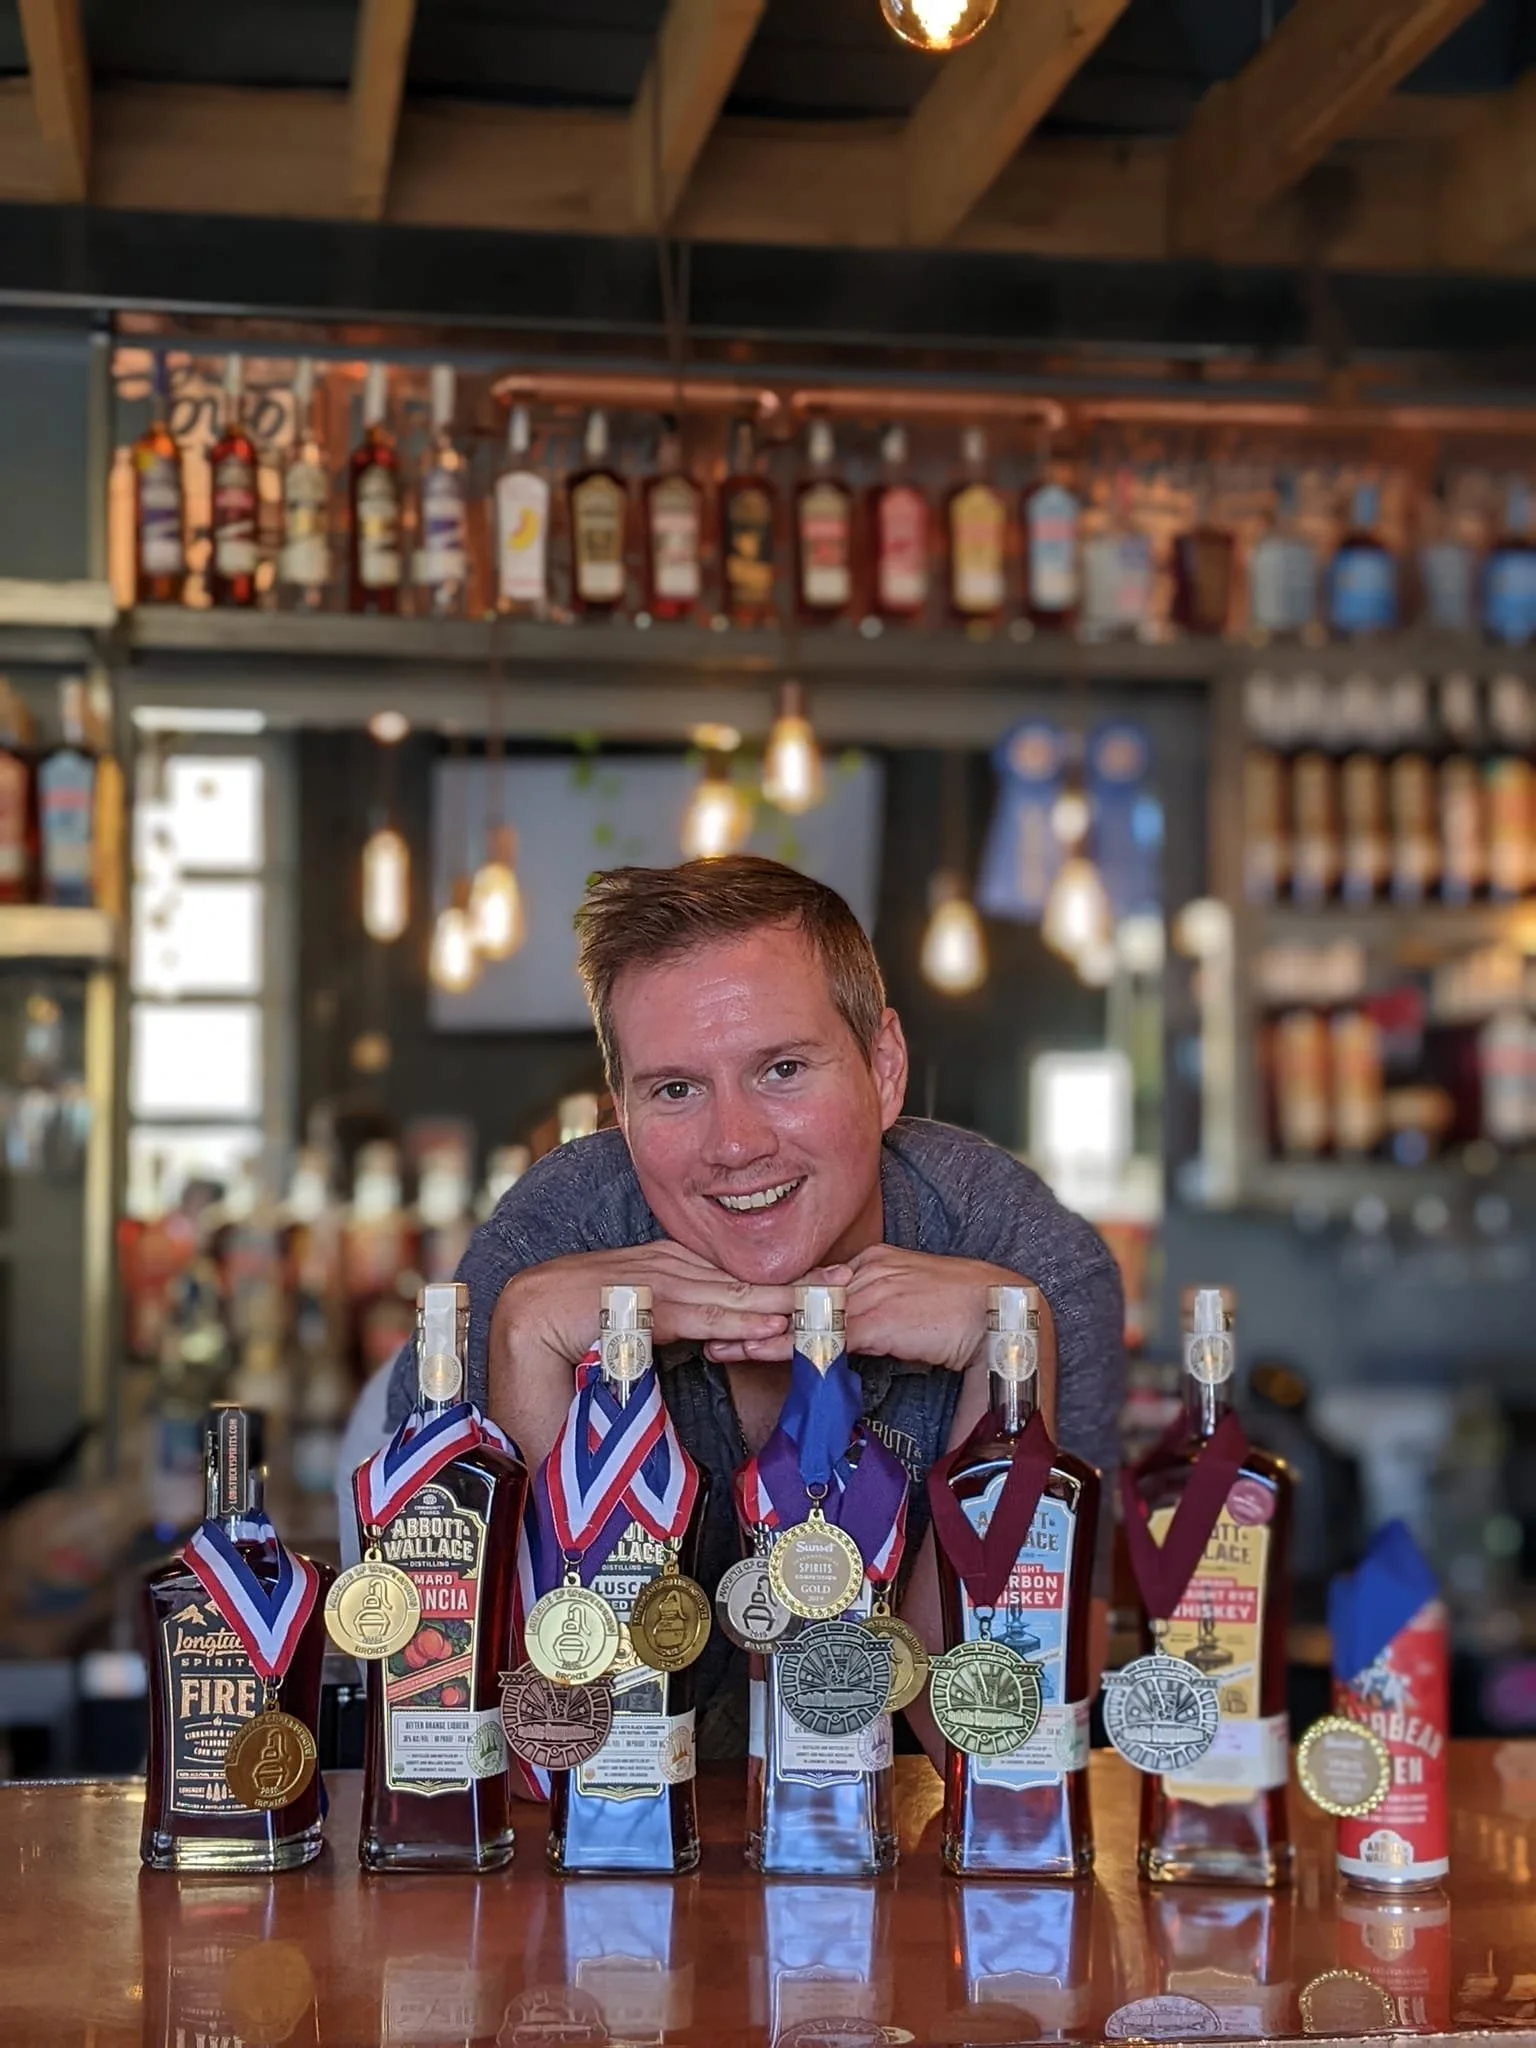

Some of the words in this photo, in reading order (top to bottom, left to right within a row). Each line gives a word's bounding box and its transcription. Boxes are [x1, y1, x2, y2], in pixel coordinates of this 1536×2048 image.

[228, 1418, 238, 1504] LONGTUCKYSPIRITS.COM
[390, 1517, 464, 1539] ABBOTT
[384, 1538, 474, 1562] WALLACE
[606, 1540, 665, 1565] LLACE
[795, 1541, 836, 1553] Sunset
[1205, 1543, 1252, 1565] LACE
[799, 1563, 833, 1574] SPIRITS
[1013, 1565, 1042, 1573] AIGHT
[415, 1575, 453, 1585] MARO
[800, 1584, 831, 1594] GOLD
[1008, 1575, 1058, 1589] RBON
[421, 1589, 468, 1611] NCIA
[998, 1591, 1058, 1605] ISKEY
[173, 1627, 245, 1658] Longtuc
[554, 1670, 589, 1680] BRONZE
[180, 1679, 256, 1719] FIRE
[1362, 1711, 1444, 1760] BBEAN
